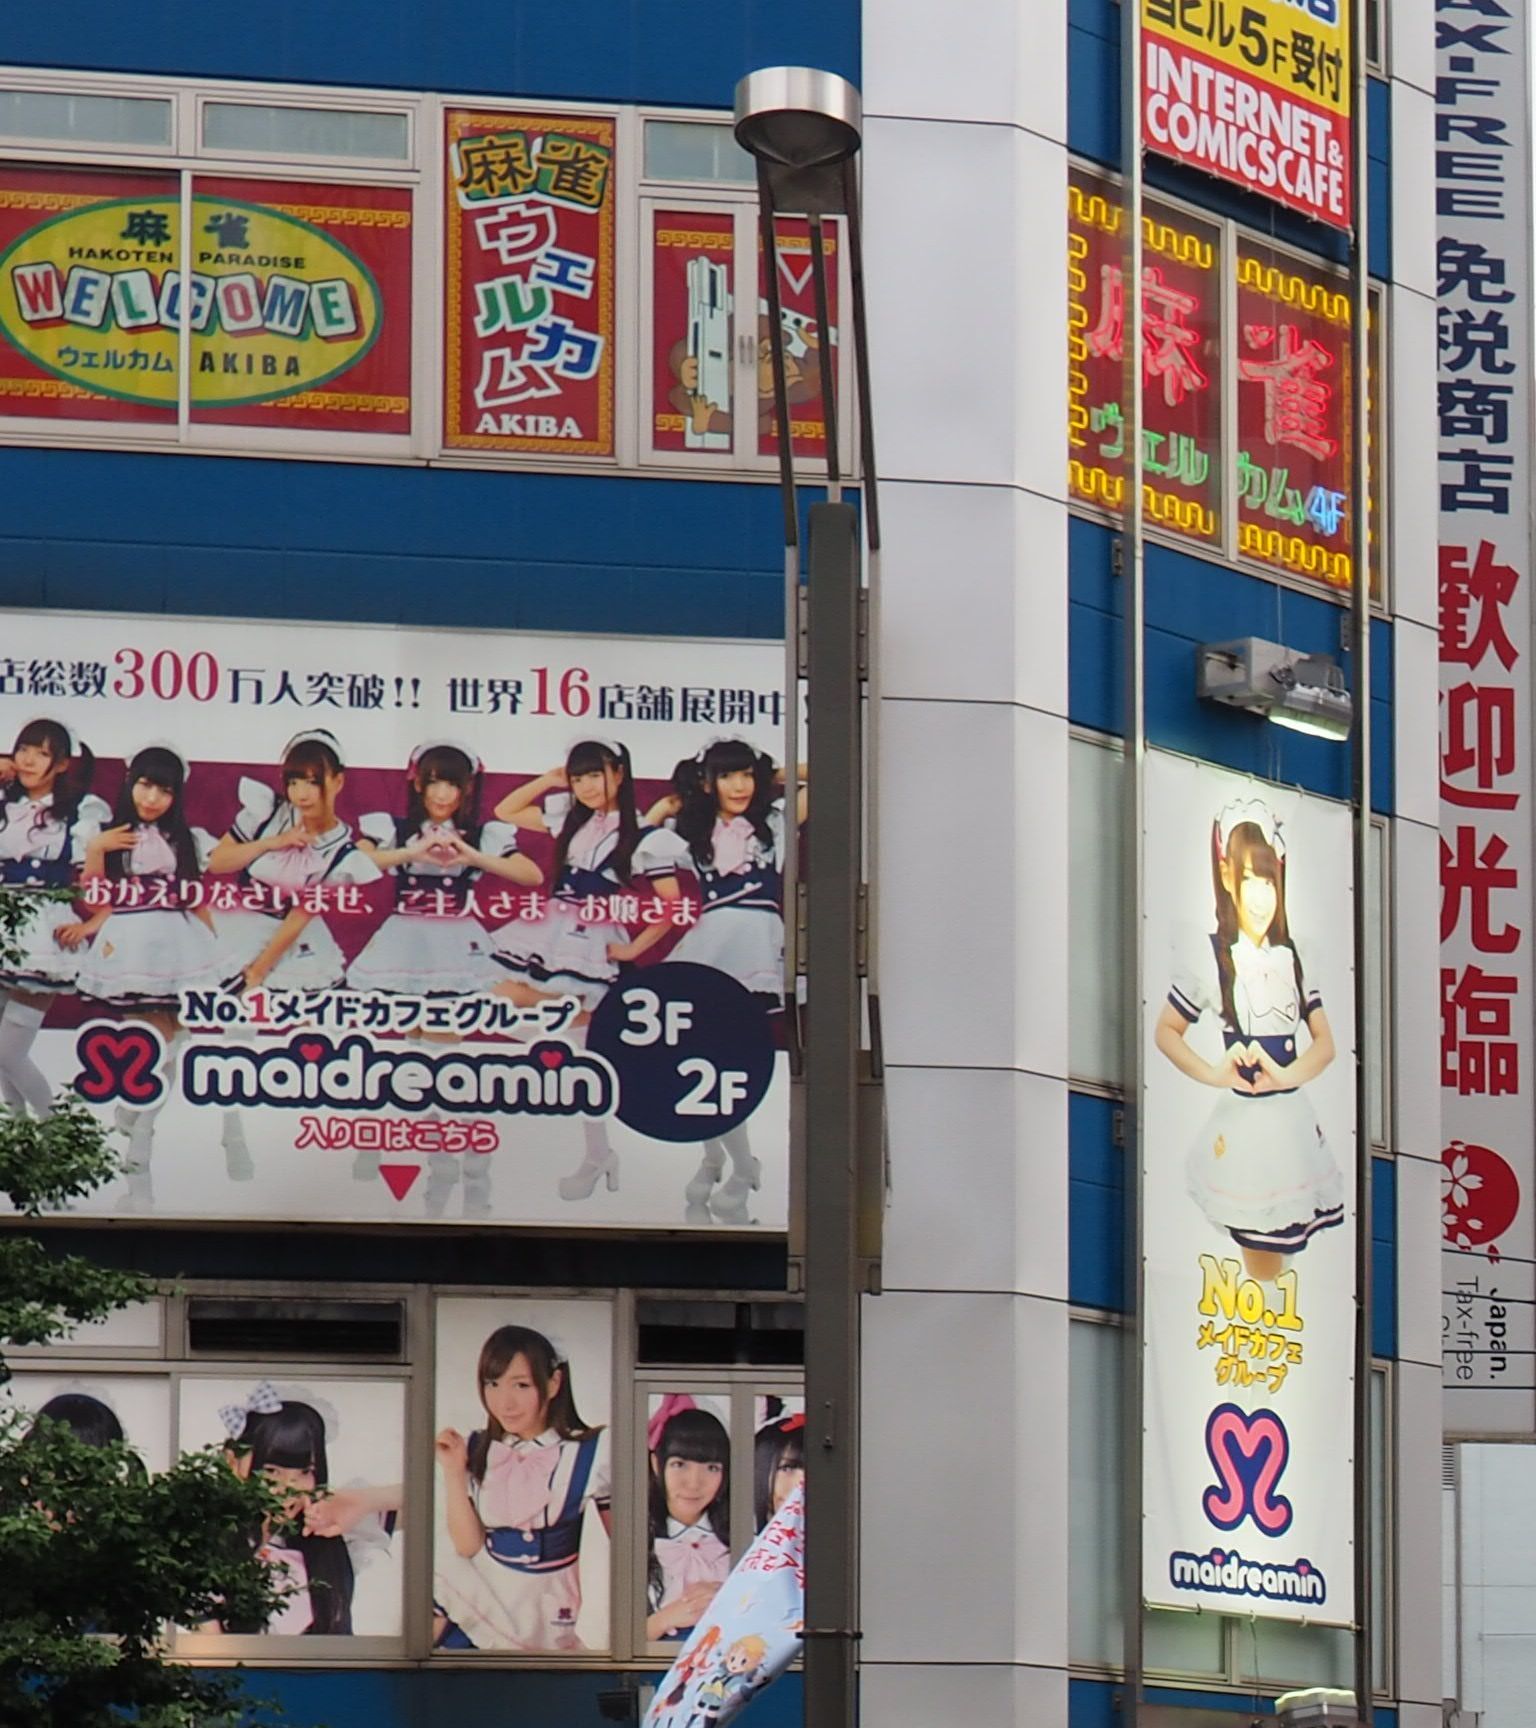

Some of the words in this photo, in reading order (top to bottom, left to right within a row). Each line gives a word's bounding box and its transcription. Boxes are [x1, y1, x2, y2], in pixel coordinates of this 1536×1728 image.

[457, 134, 609, 207] 麻雀
[118, 209, 251, 250] 麻雀
[68, 245, 173, 265] HAKOTEN
[200, 251, 306, 270] PARADISE
[14, 264, 358, 341] WELCOME
[474, 204, 604, 409] ウェルカム
[56, 344, 173, 373] ウェルカム
[200, 351, 301, 378] AKIBA
[475, 410, 583, 439] AKIBA
[620, 988, 694, 1048] 3F
[191, 1038, 604, 1116] maidreamin
[675, 1058, 748, 1116] 2F
[294, 1117, 500, 1154] 入り口はこちら
[1197, 1254, 1304, 1332] No.1
[1196, 1321, 1303, 1364] メイドカフェ
[1214, 1356, 1289, 1395] グループ
[1171, 1550, 1325, 1604] maidreamin
